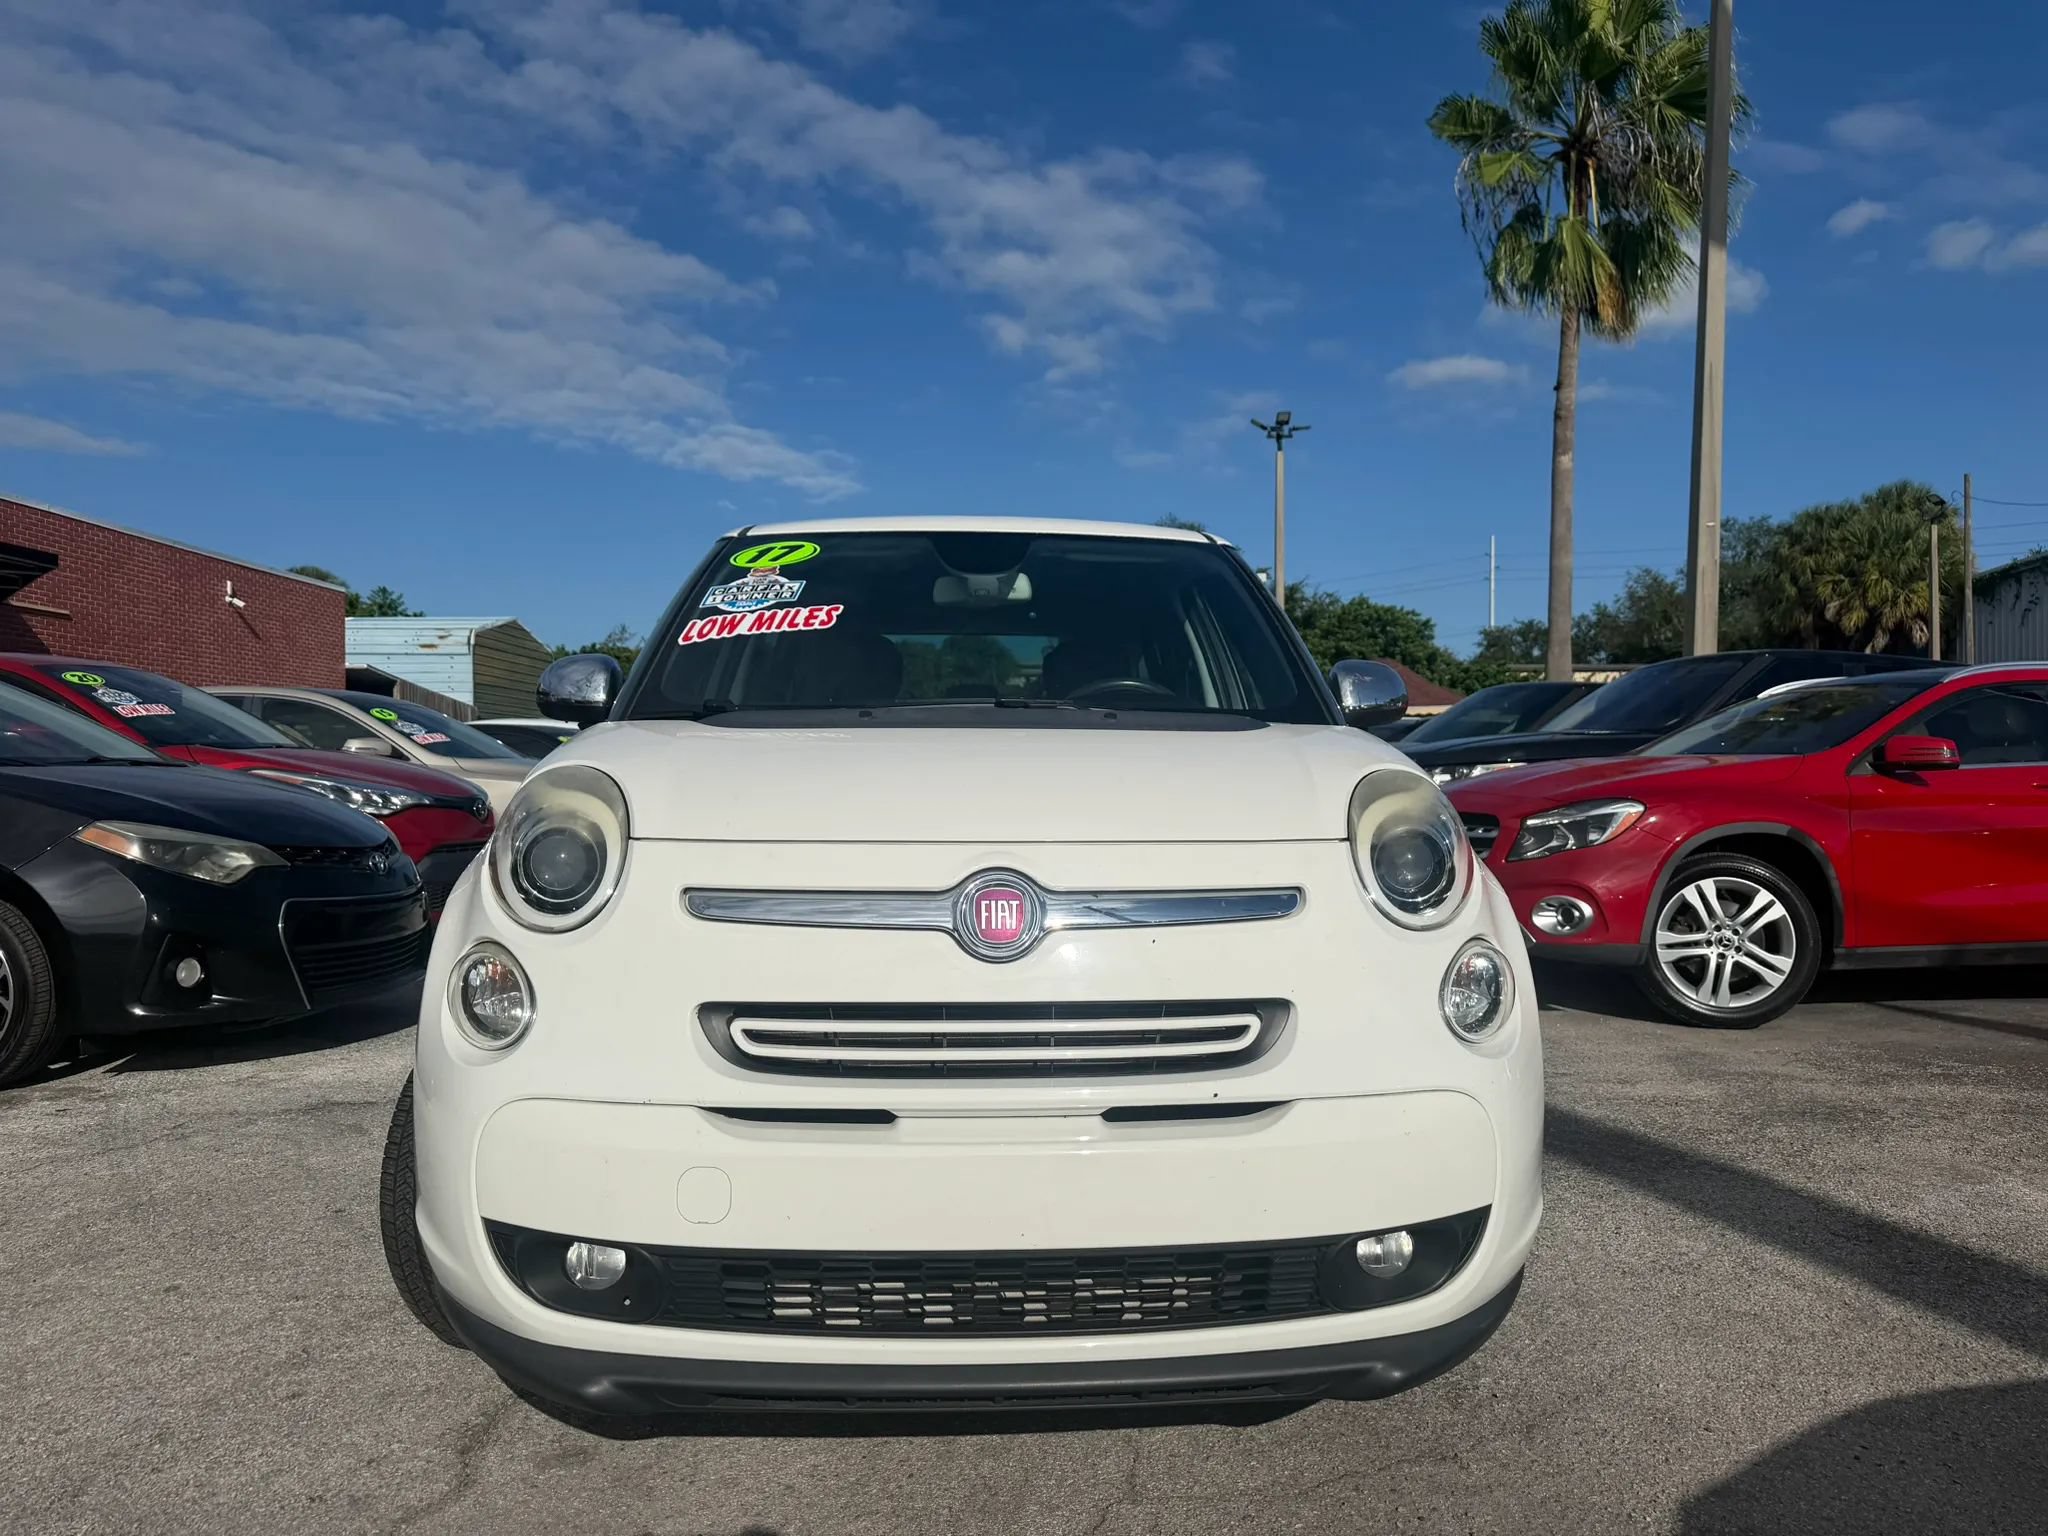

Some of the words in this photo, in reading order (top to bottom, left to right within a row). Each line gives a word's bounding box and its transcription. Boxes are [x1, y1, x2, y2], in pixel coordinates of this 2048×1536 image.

[745, 543, 806, 564] 17
[714, 584, 796, 596] CARFAX
[723, 591, 793, 601] OWNER
[681, 613, 747, 643] LOW
[747, 605, 841, 633] MILES
[70, 673, 99, 683] 20
[980, 900, 1020, 930] FIAT
